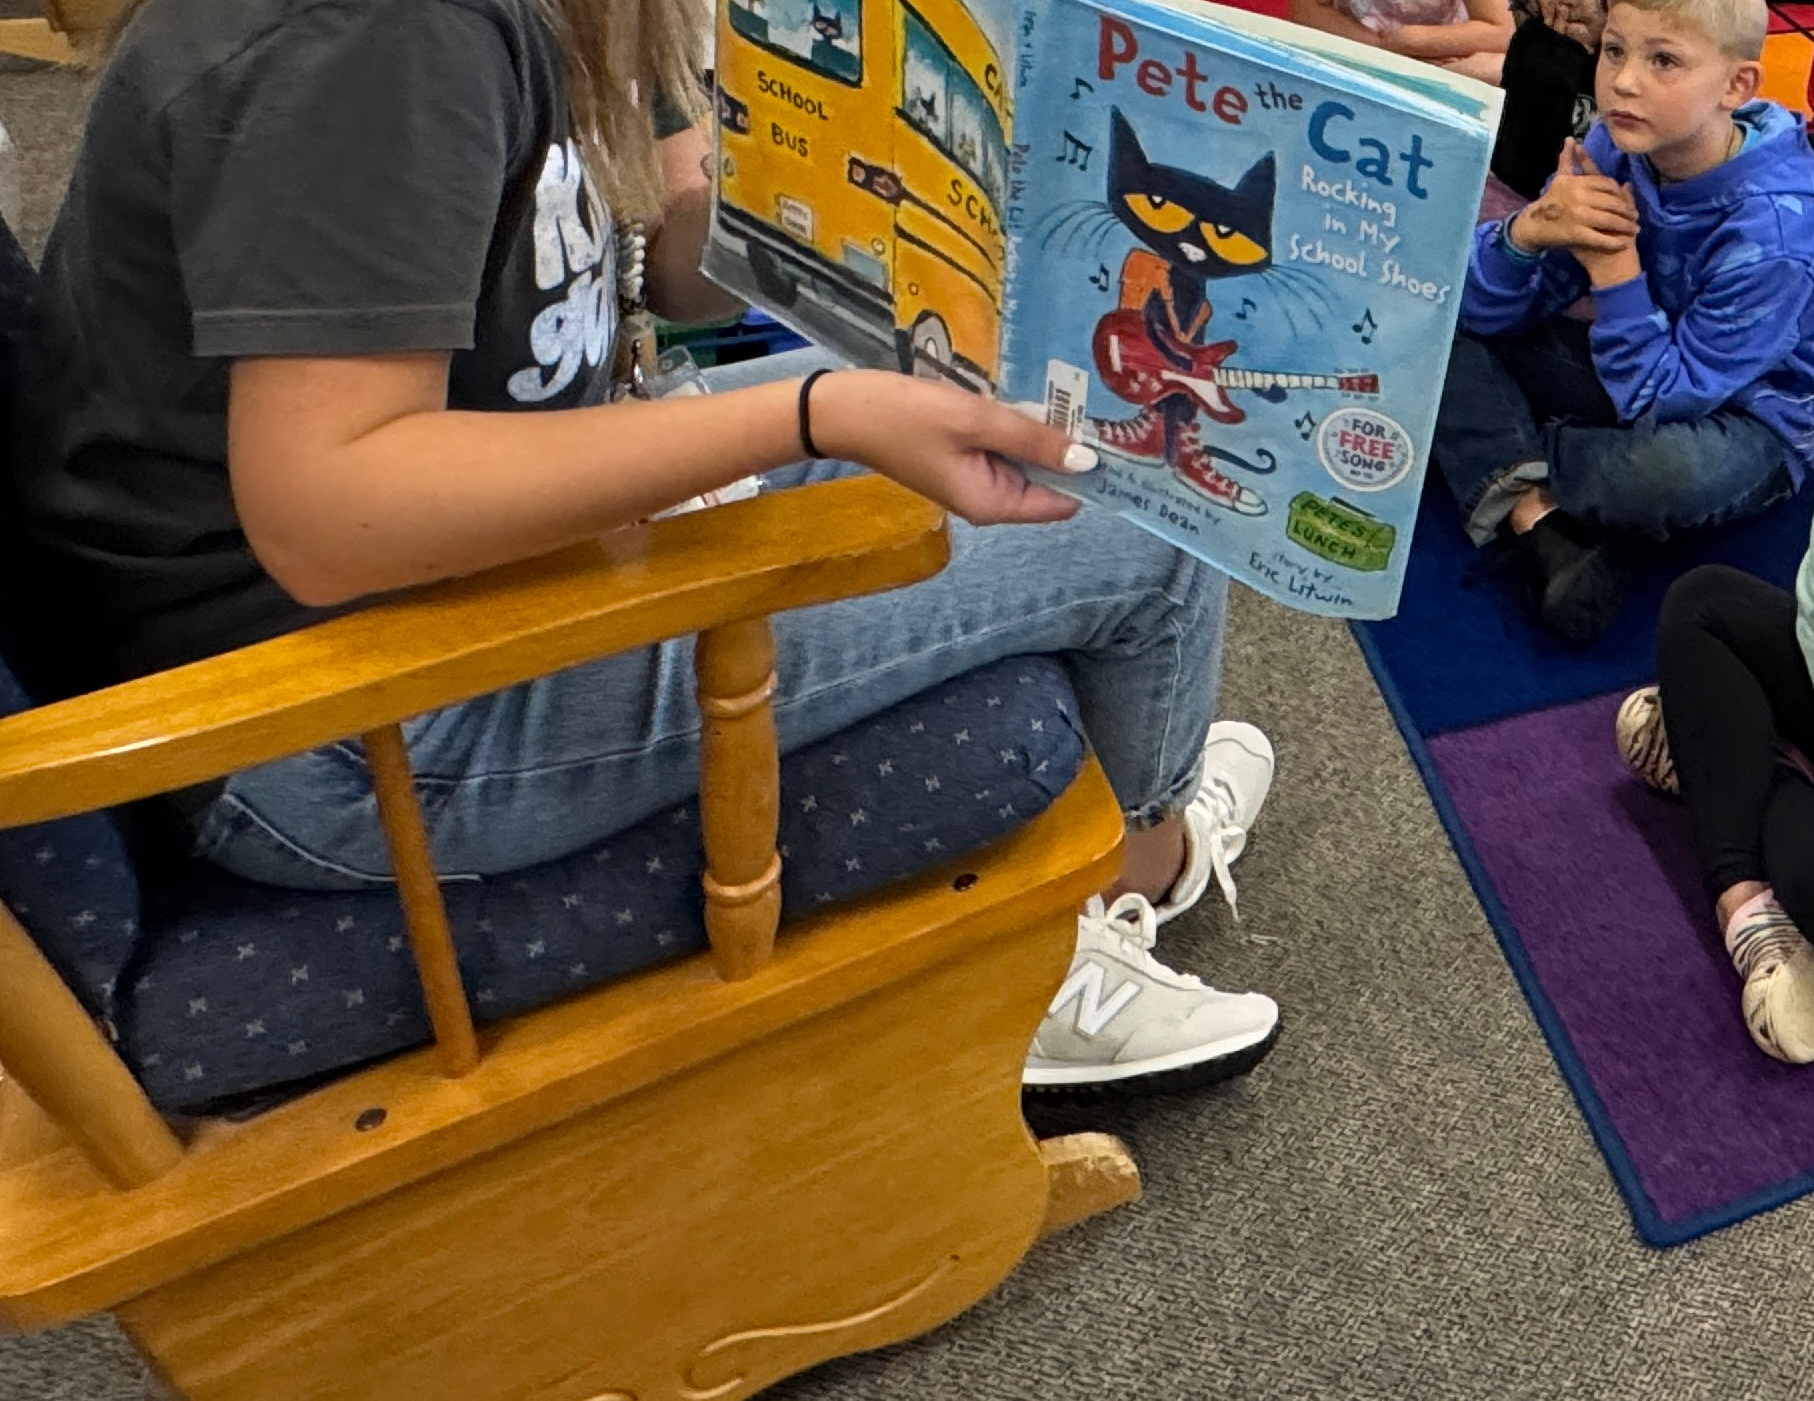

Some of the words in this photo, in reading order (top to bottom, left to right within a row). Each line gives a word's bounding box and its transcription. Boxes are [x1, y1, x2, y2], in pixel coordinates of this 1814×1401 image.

[757, 70, 829, 121] SCHOOL
[1097, 15, 1249, 126] Pete
[1254, 82, 1303, 111] the
[1308, 101, 1434, 200] Cat
[771, 122, 808, 158] BUS
[1302, 164, 1398, 228] Rocking
[1322, 203, 1347, 235] in
[1289, 233, 1368, 279] School
[1380, 258, 1450, 305] Shoes
[1338, 429, 1396, 460] FREE
[1352, 418, 1387, 440] FOR
[1340, 449, 1387, 472] SONG
[1096, 478, 1151, 511] James
[1158, 503, 1200, 535] Dean
[1294, 520, 1357, 560] LUNCH
[1249, 551, 1280, 584] Eric
[1288, 575, 1354, 607] Litwin
[1314, 568, 1334, 584] by
